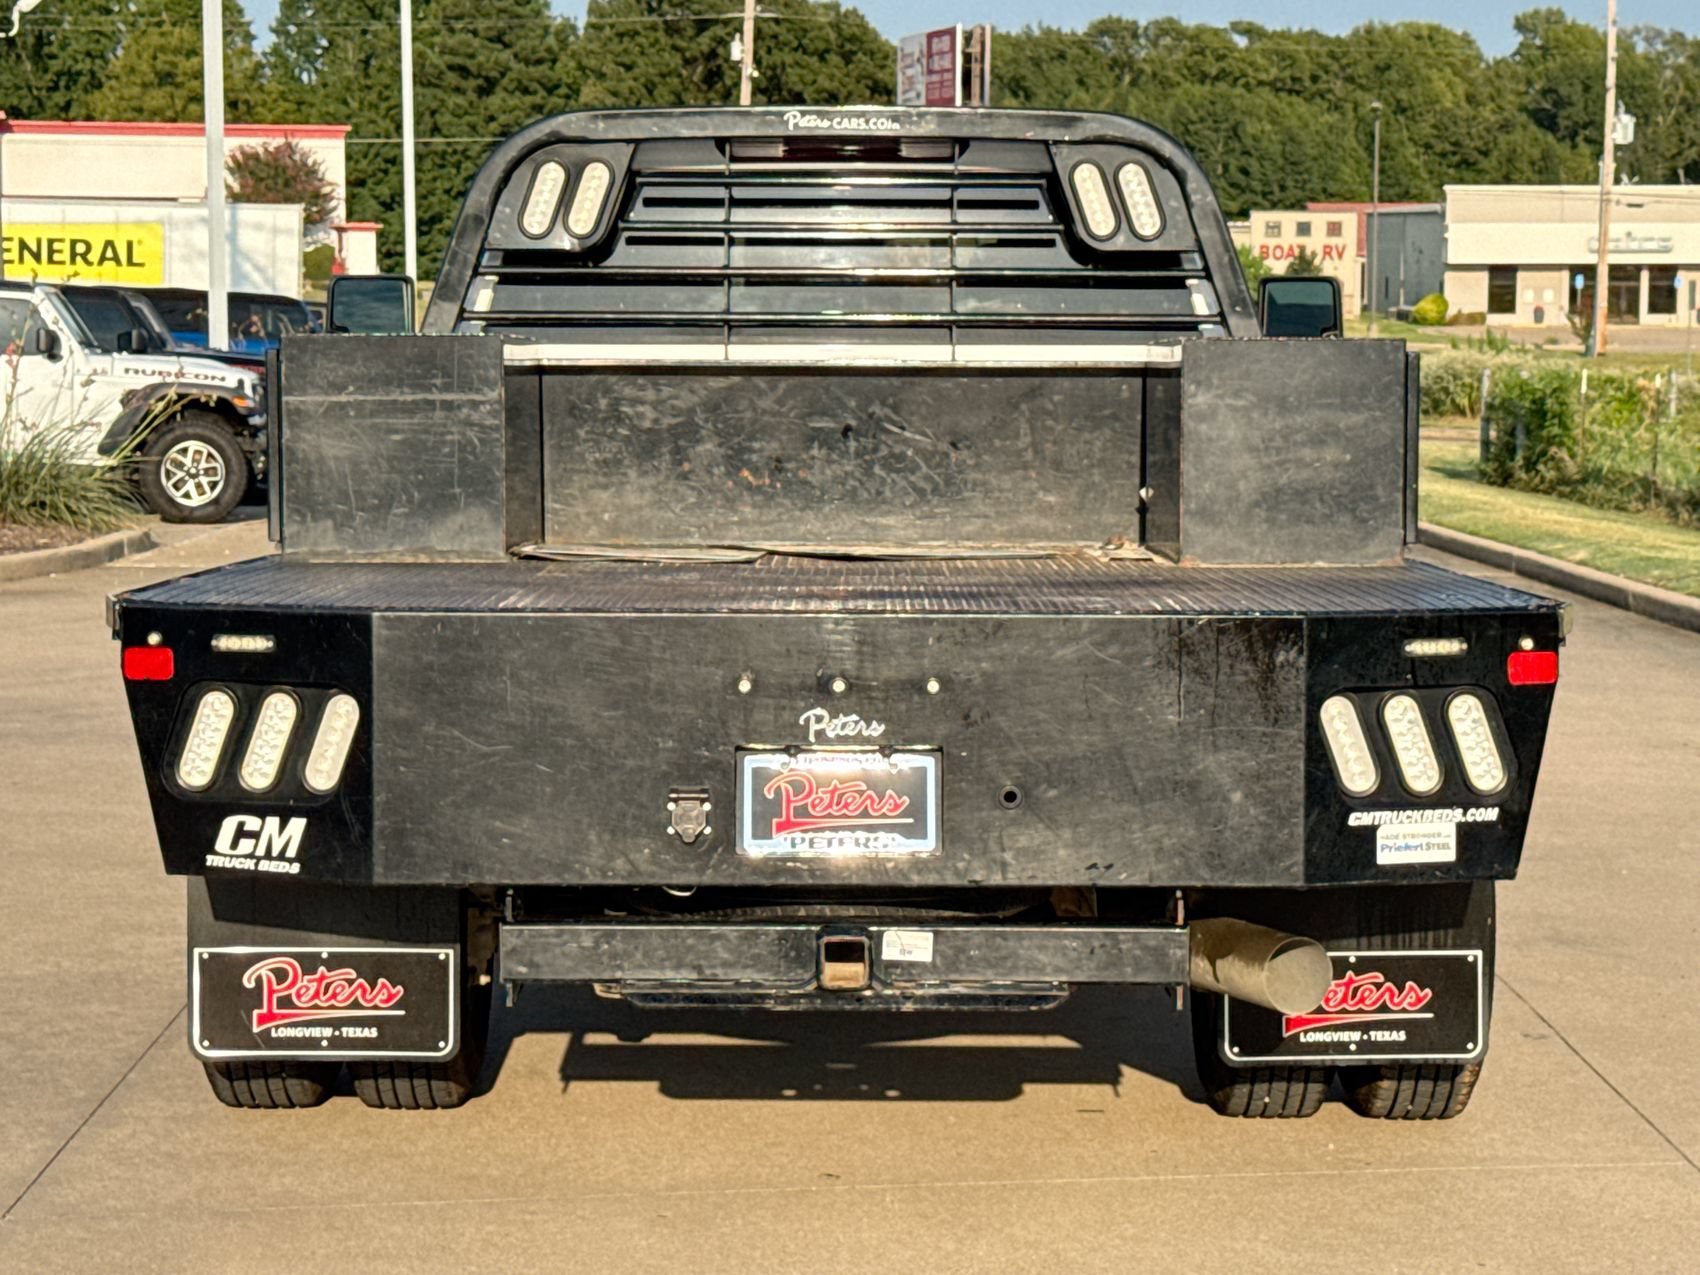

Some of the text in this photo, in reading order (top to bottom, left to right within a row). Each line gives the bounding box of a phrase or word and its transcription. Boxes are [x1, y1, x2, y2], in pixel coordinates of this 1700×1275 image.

[1322, 244, 1347, 261] RV
[124, 367, 227, 383] RUBICON
[799, 707, 886, 743] Peters
[764, 770, 912, 833] Peters
[1347, 807, 1500, 826] CMTRUCKBEDS.COM
[214, 815, 308, 858] CM
[205, 854, 301, 874] TRUCK BEDS
[242, 957, 404, 1030] Peters
[1312, 970, 1433, 1016] eters
[271, 1027, 378, 1038] LONGVIEW TEXAS
[1299, 1030, 1407, 1043] LONGVIEW TEXAS
